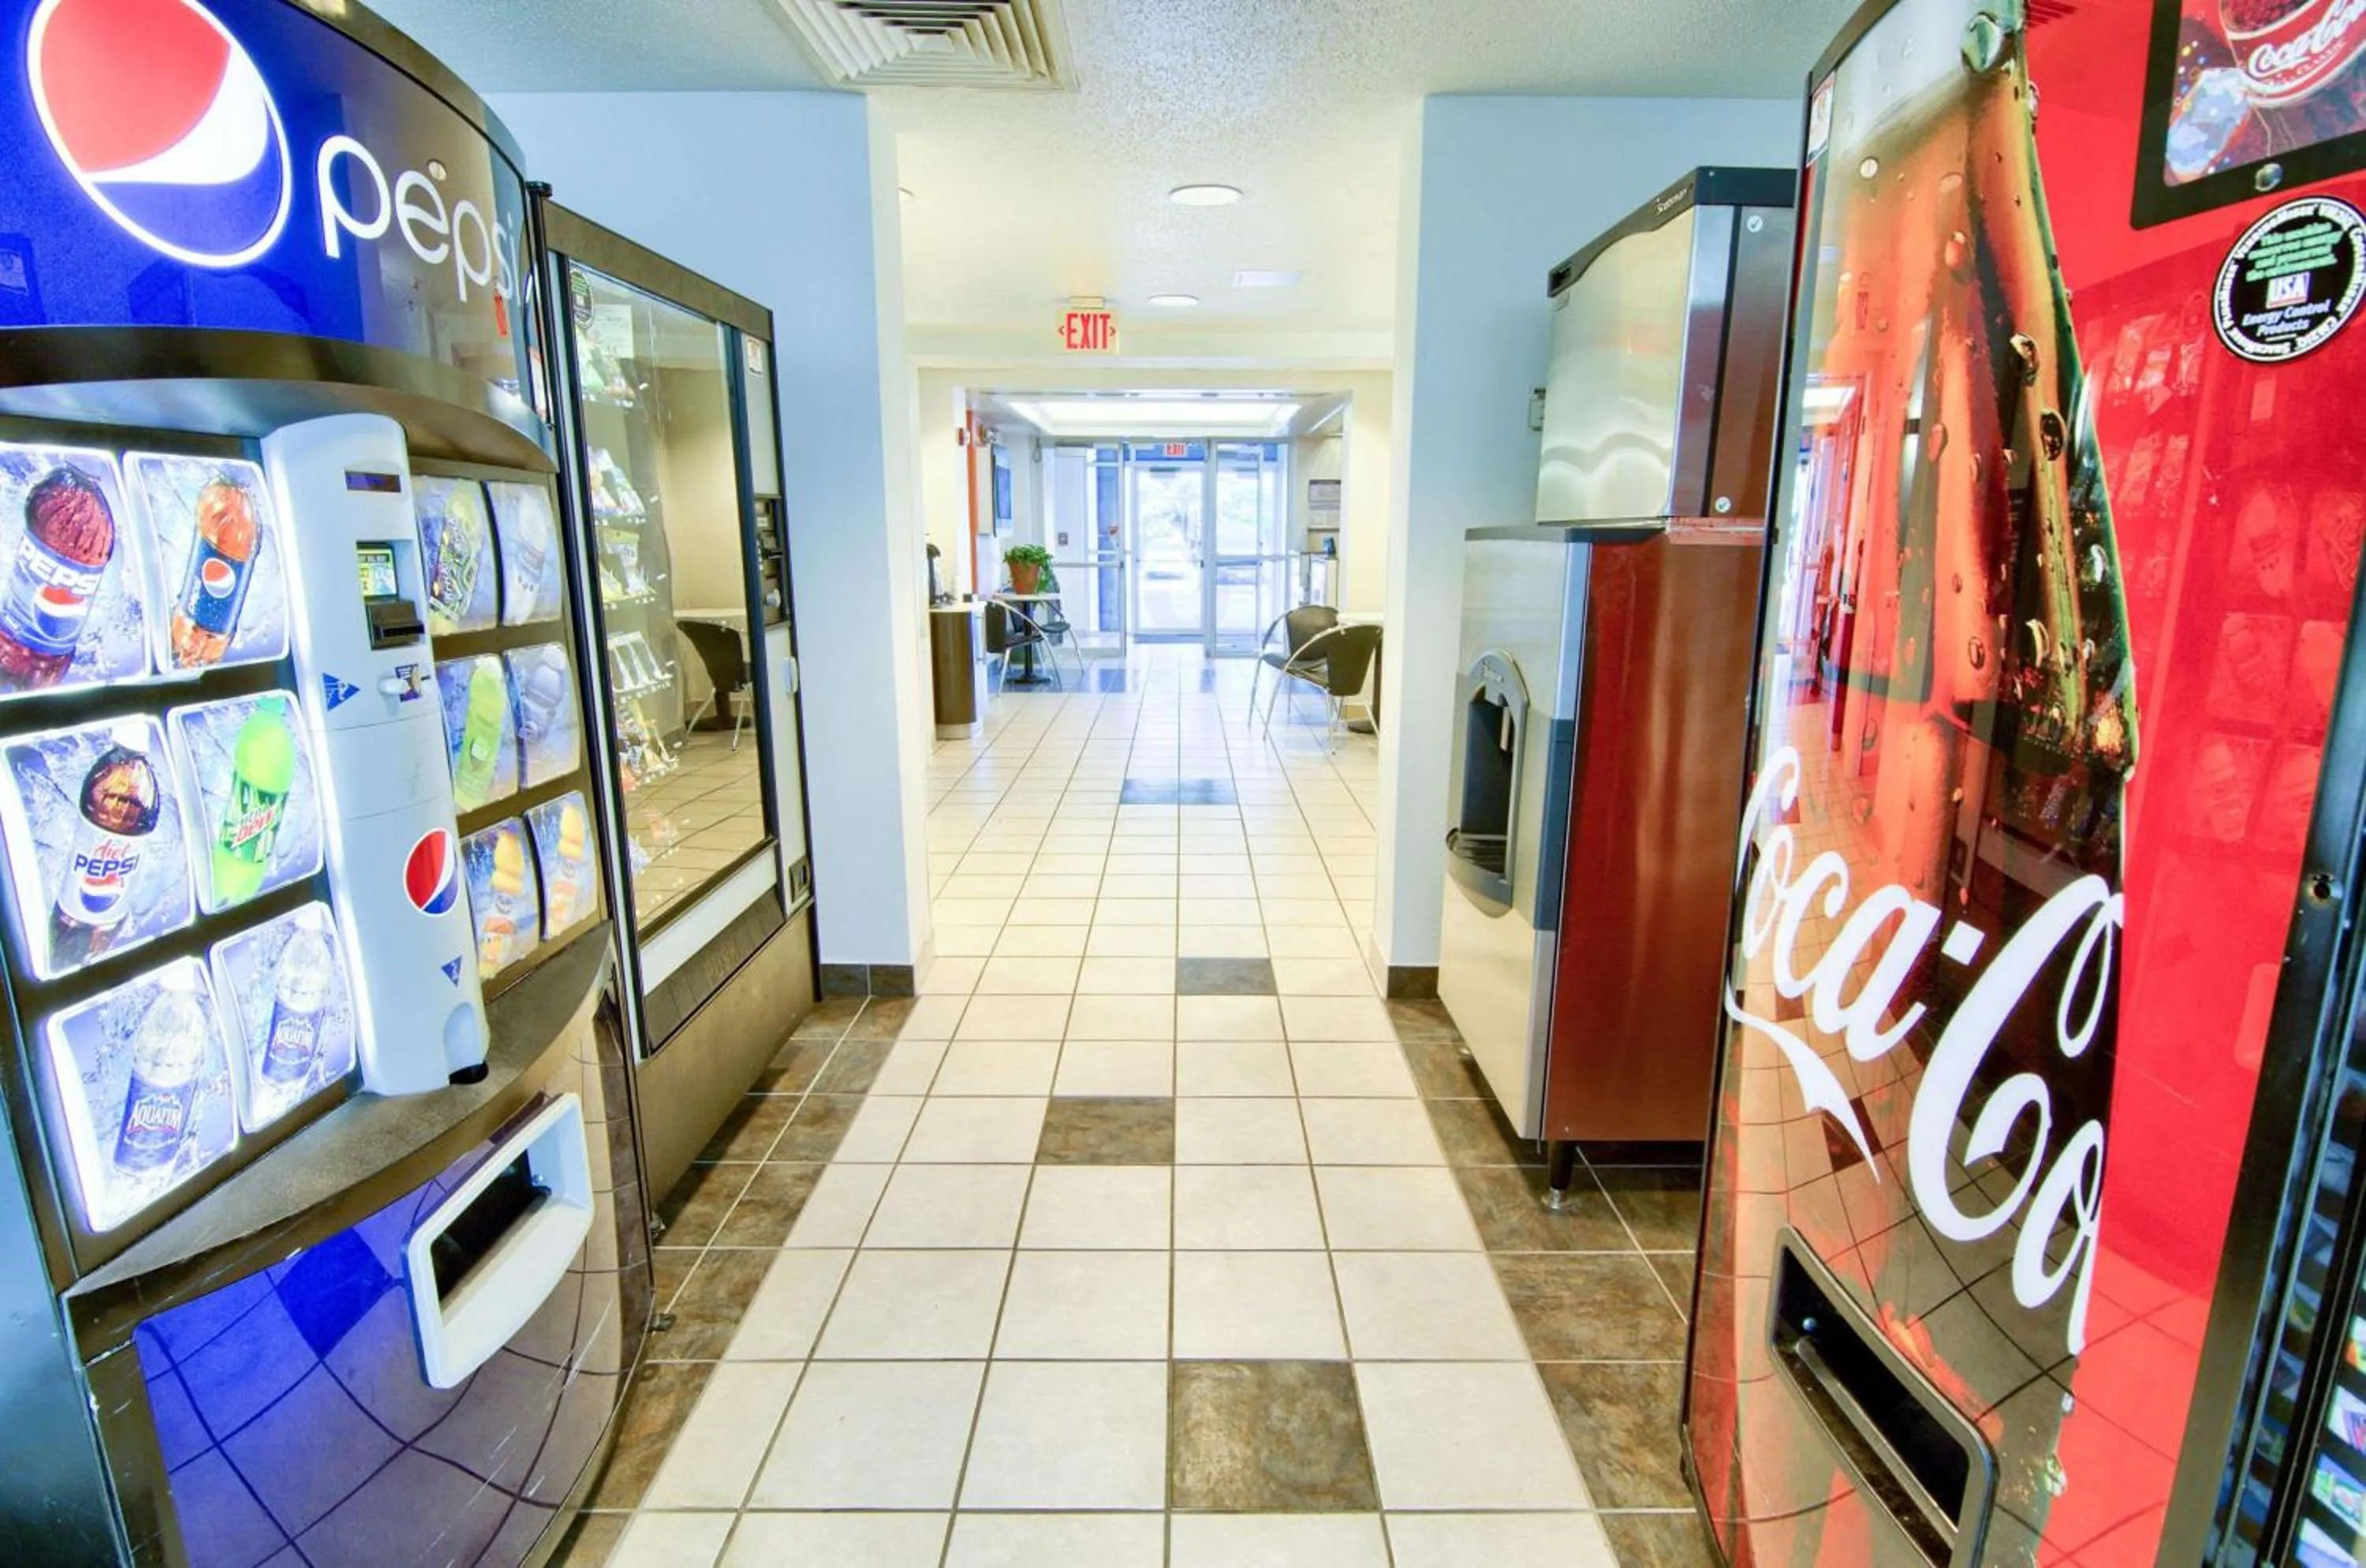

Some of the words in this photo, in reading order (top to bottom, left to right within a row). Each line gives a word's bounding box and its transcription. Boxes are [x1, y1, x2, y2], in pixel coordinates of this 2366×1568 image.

[316, 135, 521, 306] pepsi
[2269, 271, 2311, 302] USA
[2242, 308, 2283, 327] Energy
[2283, 299, 2331, 318] Control
[1066, 313, 1110, 349] EXIT
[2256, 318, 2311, 337] Products
[94, 838, 131, 858] diet
[73, 853, 140, 877] PEPSI
